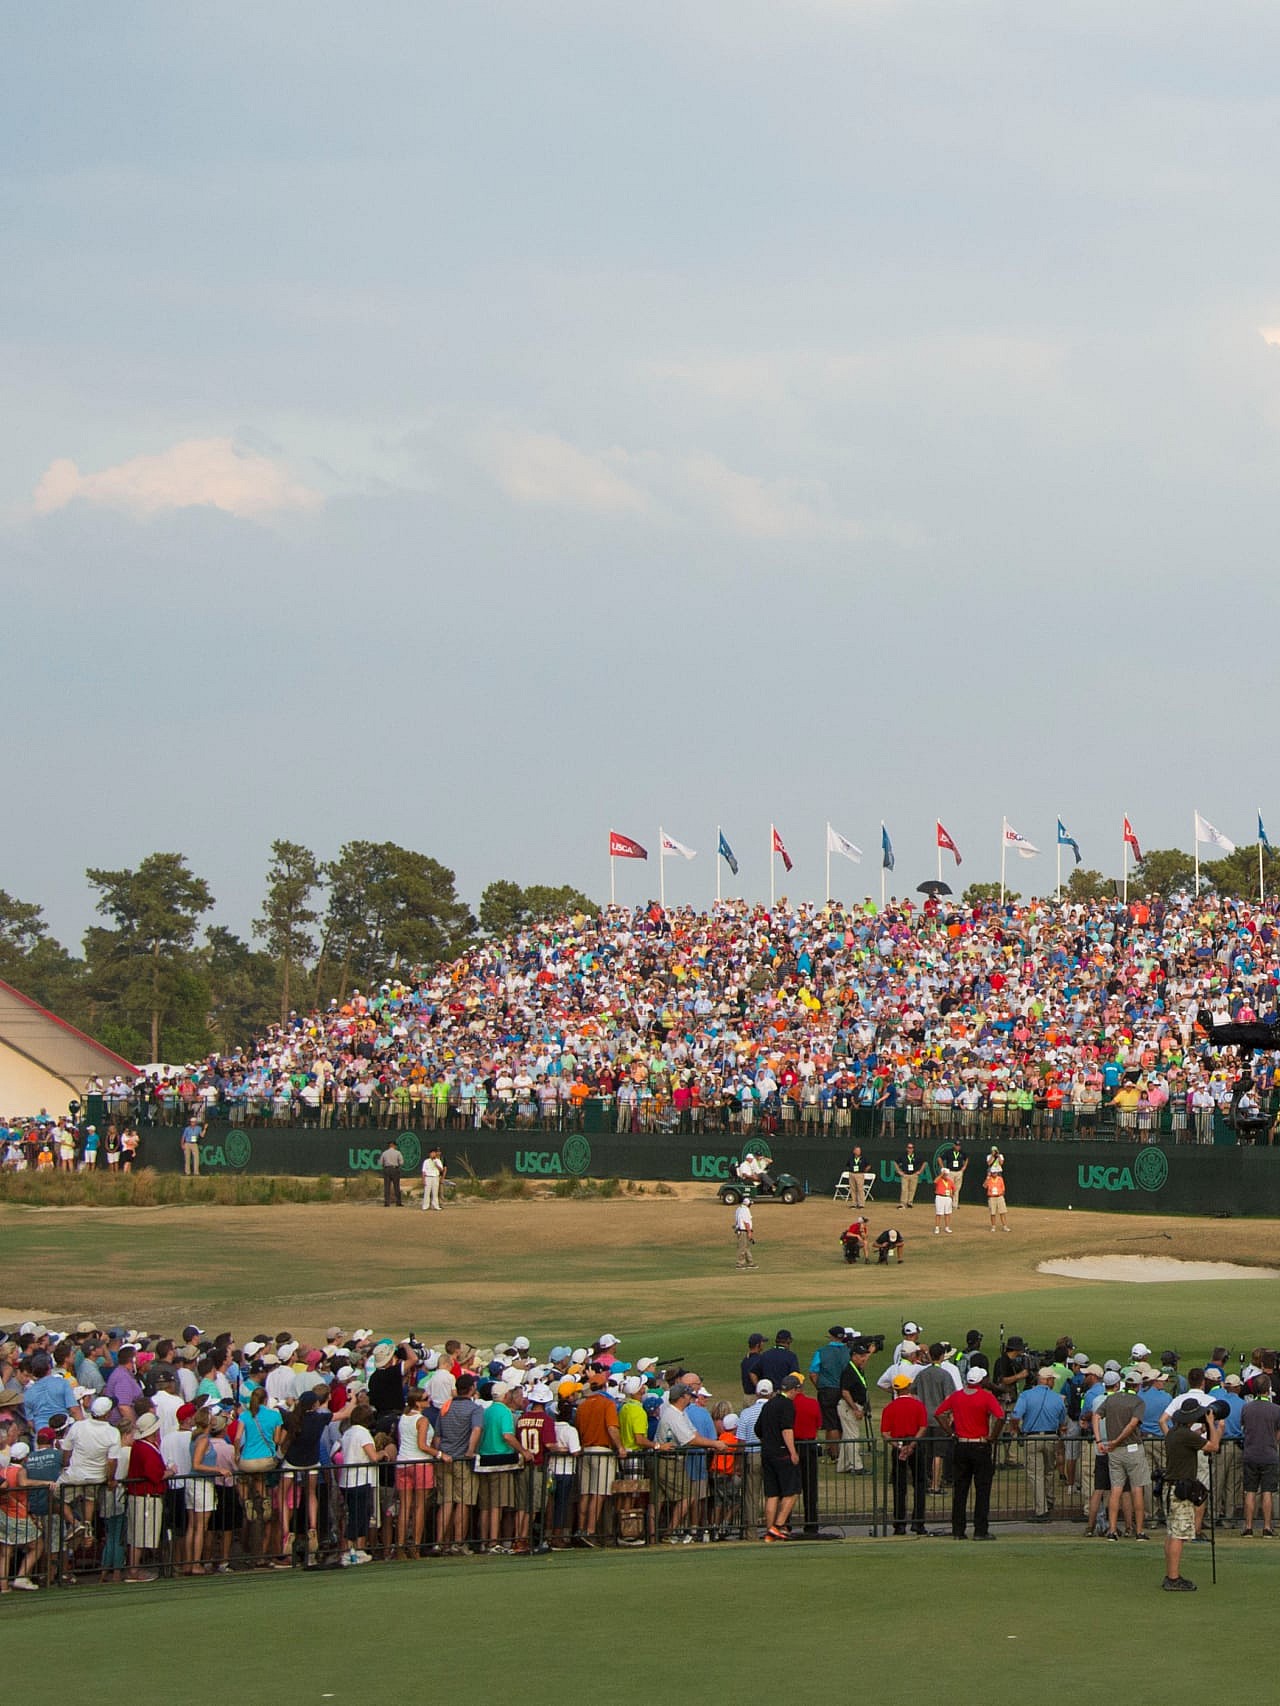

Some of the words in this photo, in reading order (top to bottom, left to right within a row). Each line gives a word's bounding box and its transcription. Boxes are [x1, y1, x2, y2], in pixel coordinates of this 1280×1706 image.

[612, 842, 634, 854] USGA
[350, 1146, 383, 1170] USG
[515, 1152, 562, 1173] USGA
[1078, 1165, 1134, 1191] USGA
[521, 1428, 539, 1454] 10
